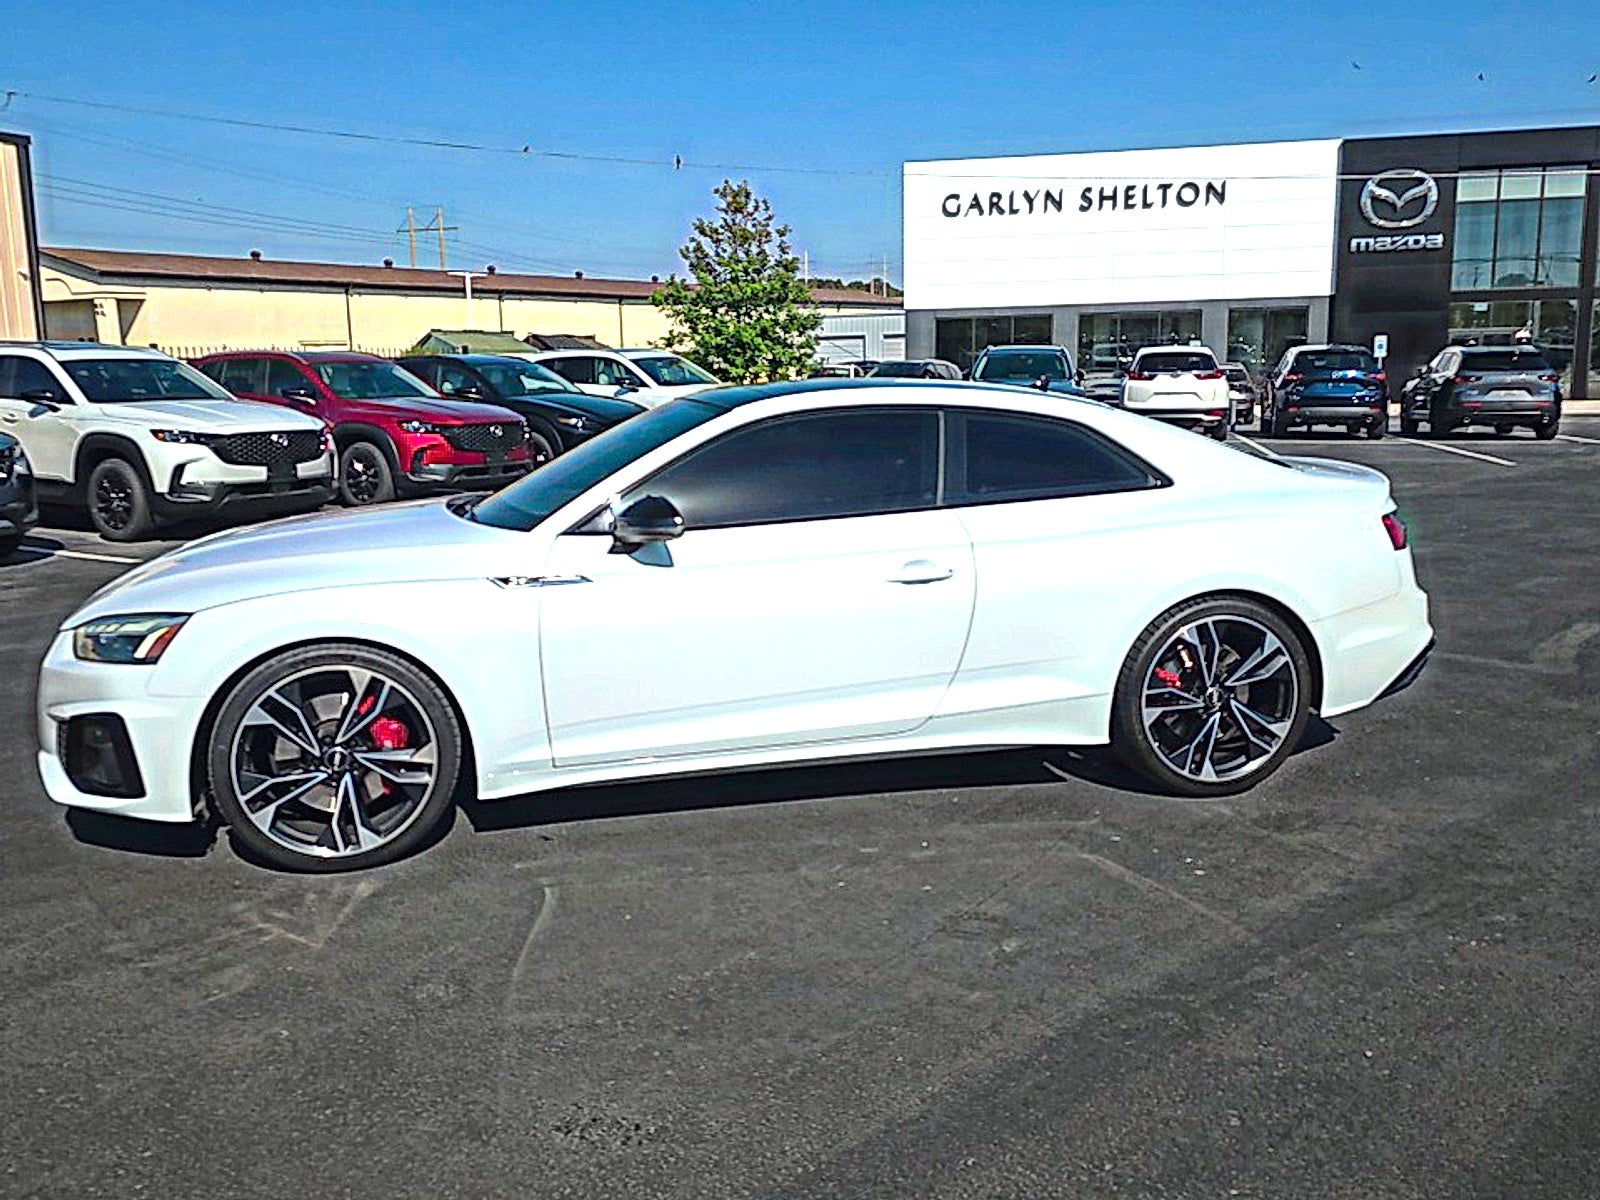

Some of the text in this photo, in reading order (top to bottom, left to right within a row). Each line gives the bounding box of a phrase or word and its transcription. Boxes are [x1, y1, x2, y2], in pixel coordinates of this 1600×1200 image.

[942, 180, 1226, 218] GARLYN SHELTON
[1350, 233, 1444, 252] mazda
